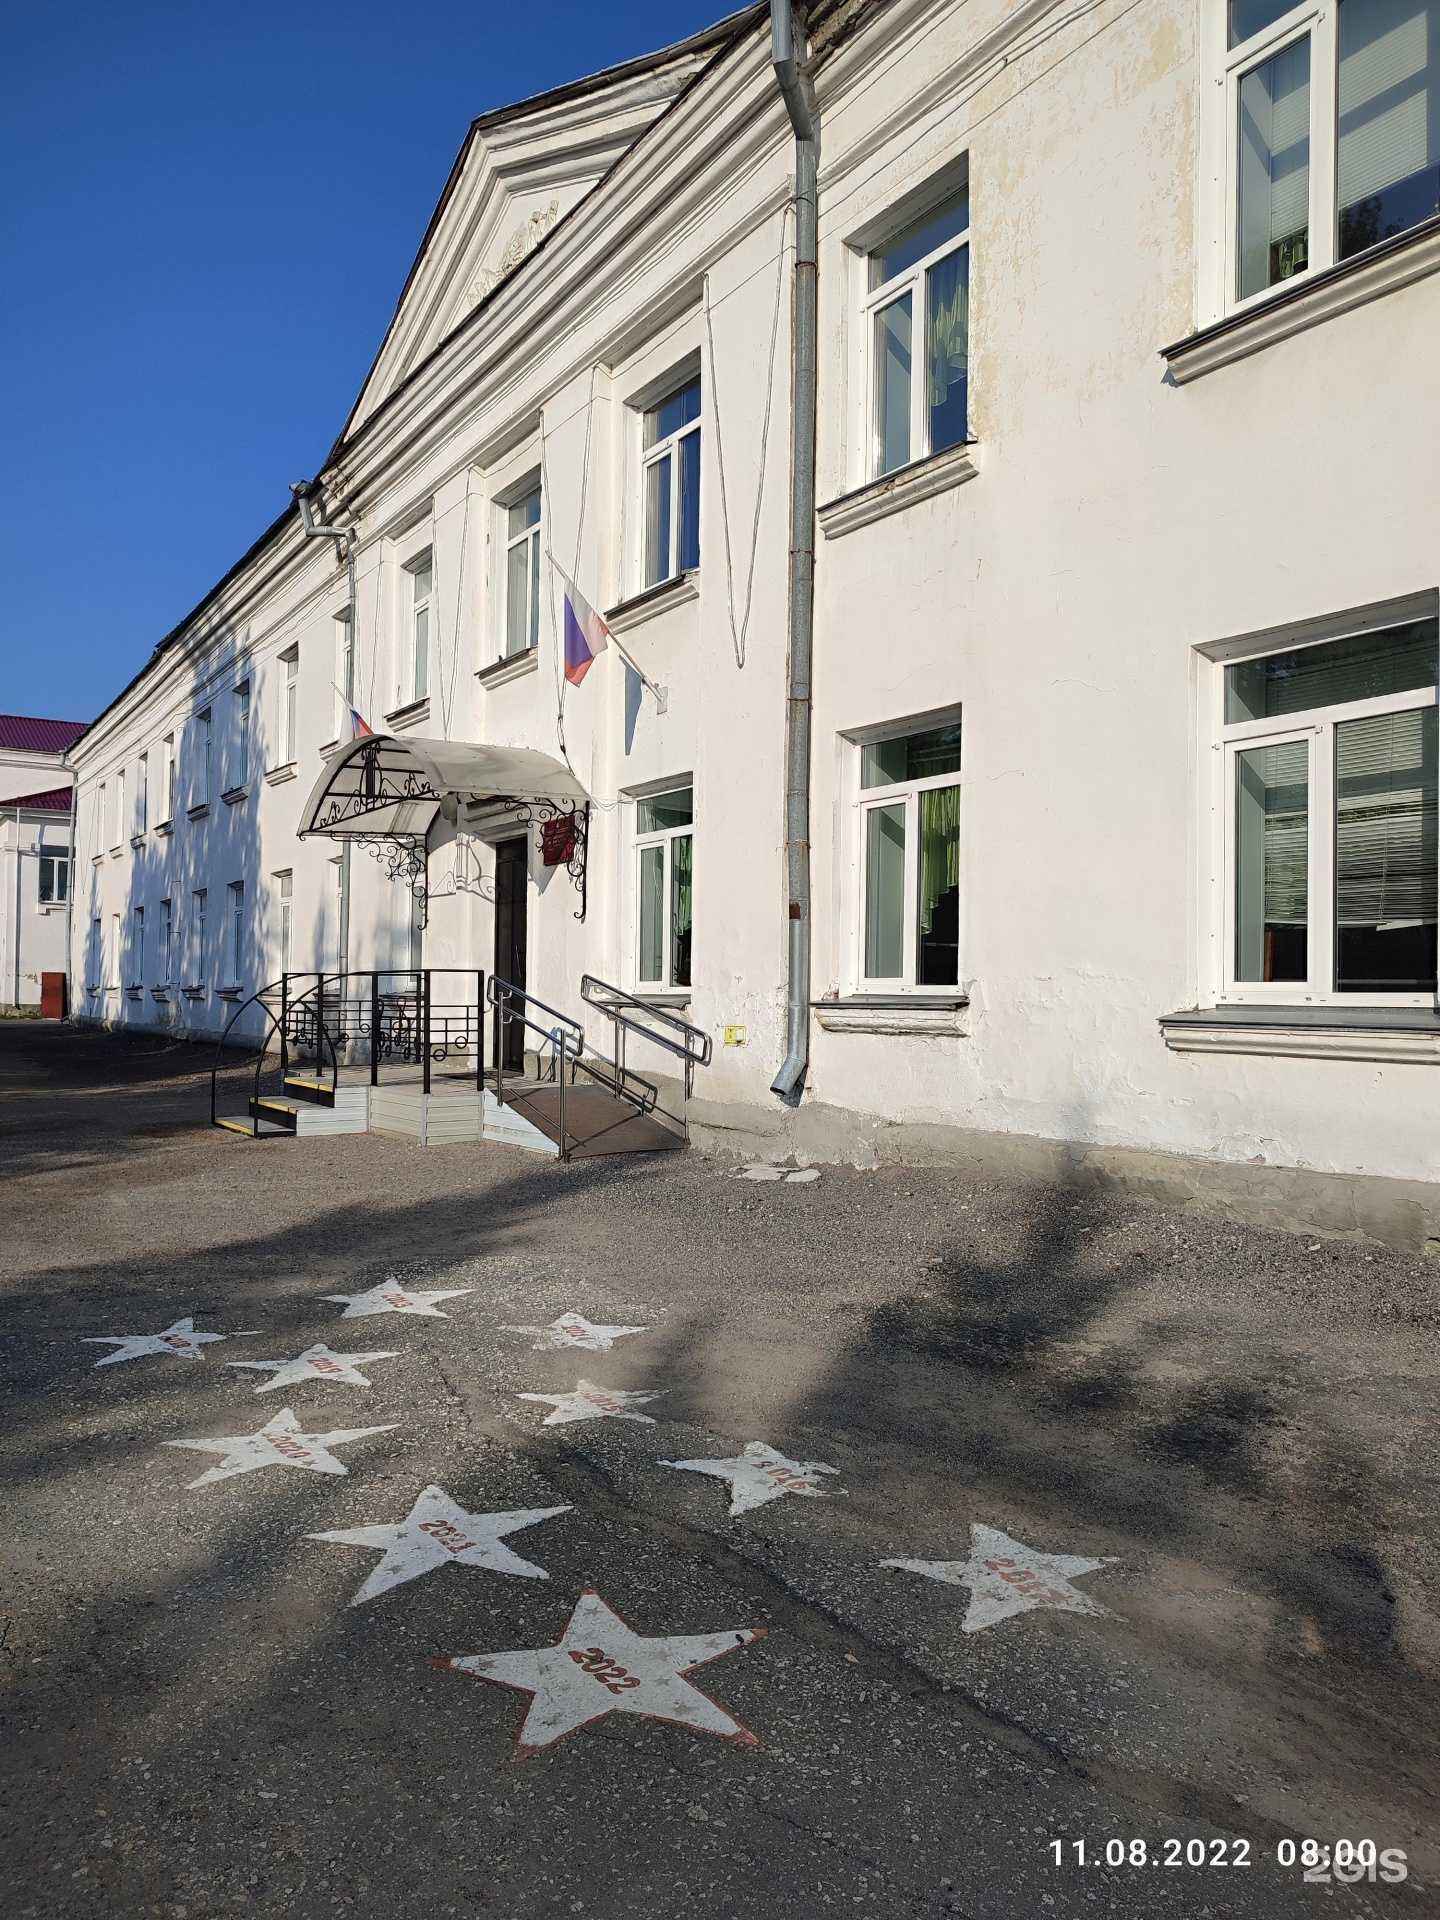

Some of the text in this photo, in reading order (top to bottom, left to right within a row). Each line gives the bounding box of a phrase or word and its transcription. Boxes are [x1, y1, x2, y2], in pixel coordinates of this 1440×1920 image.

[267, 1435, 312, 1459] 2020
[418, 1519, 477, 1555] 2021
[567, 1647, 641, 1695] 2022
